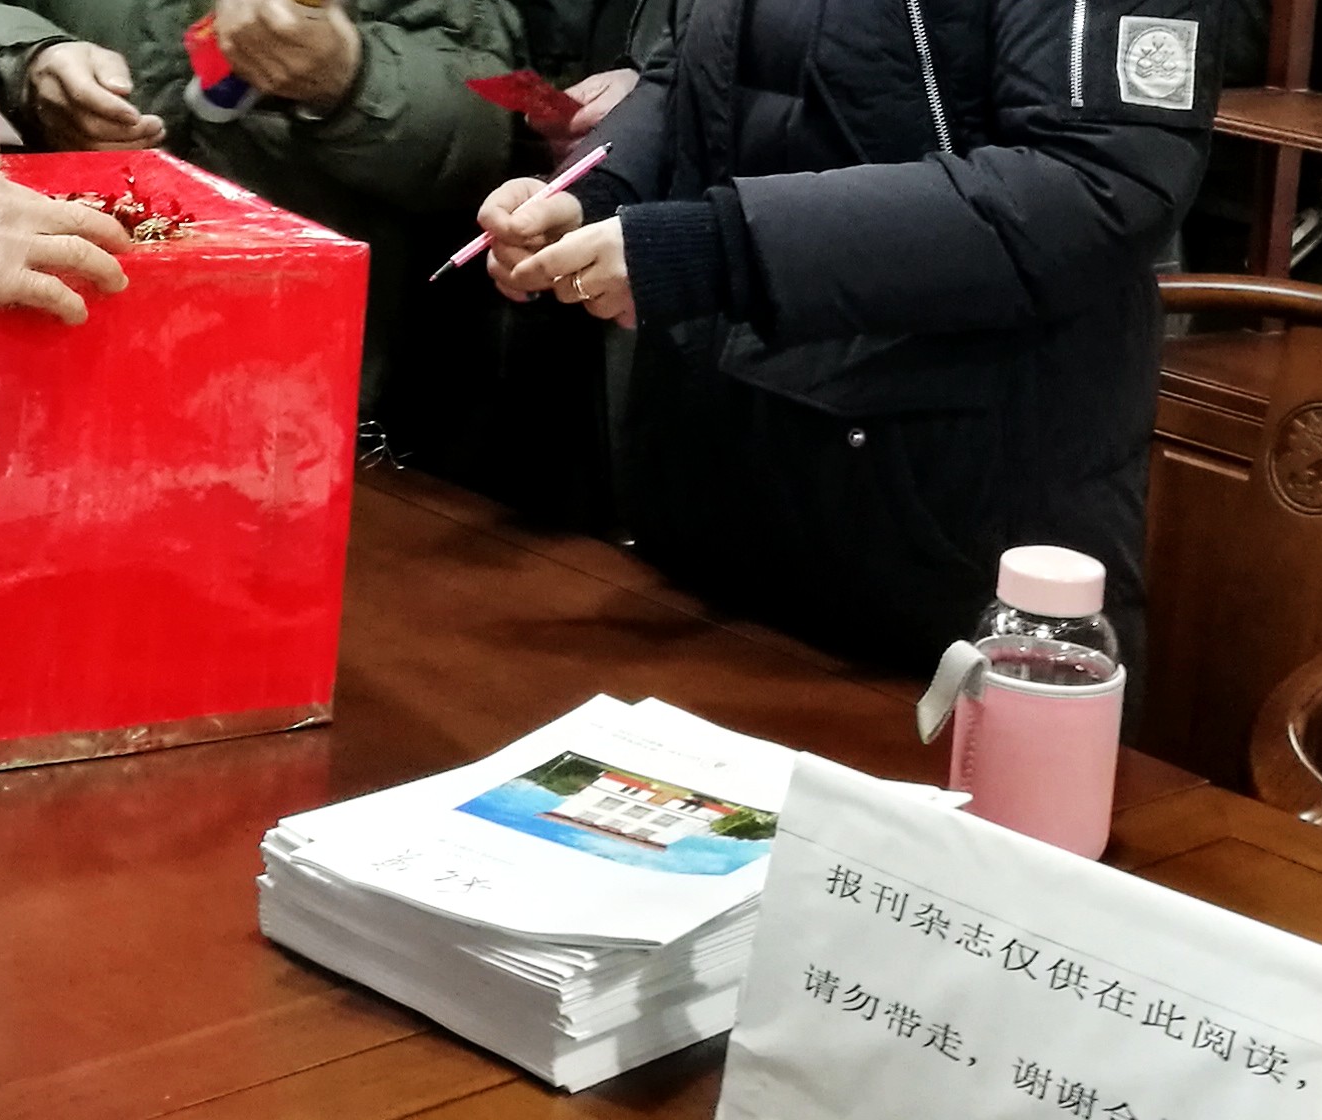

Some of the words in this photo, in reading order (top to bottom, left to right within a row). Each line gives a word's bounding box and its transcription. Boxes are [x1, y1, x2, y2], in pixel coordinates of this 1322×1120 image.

[825, 864, 1308, 1090] 报刊杂志仅供在此阅读，
